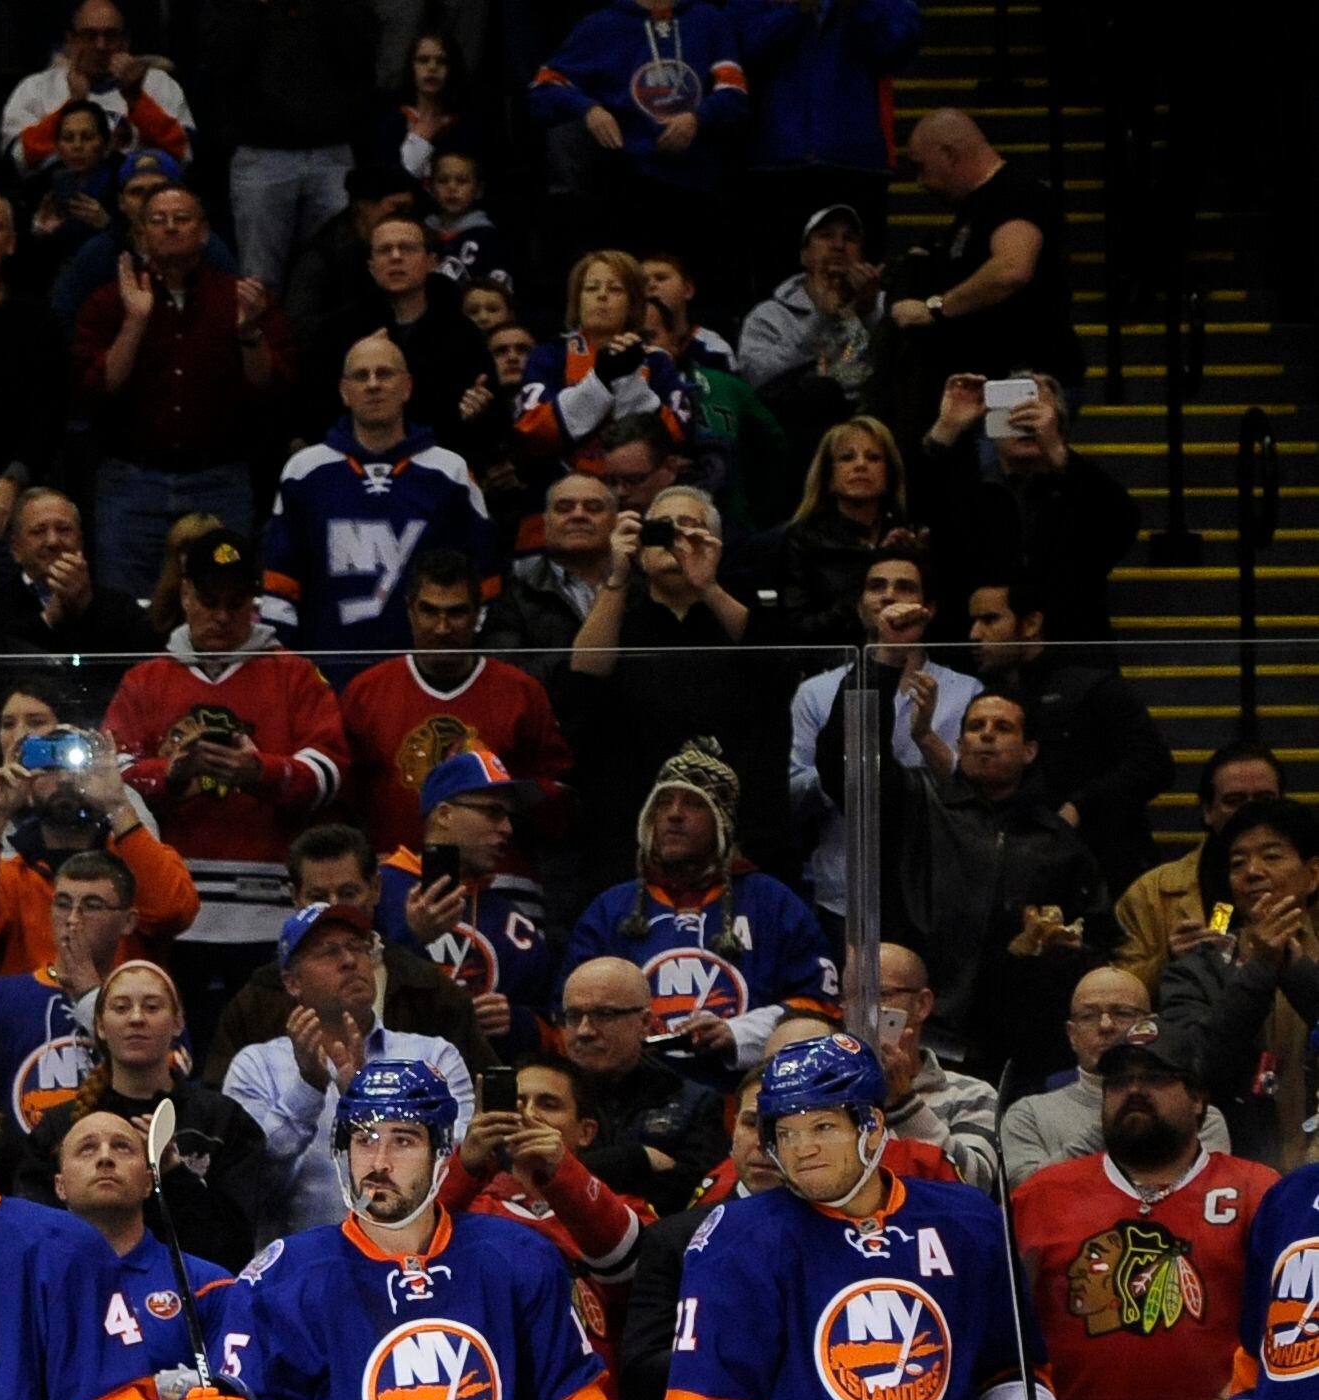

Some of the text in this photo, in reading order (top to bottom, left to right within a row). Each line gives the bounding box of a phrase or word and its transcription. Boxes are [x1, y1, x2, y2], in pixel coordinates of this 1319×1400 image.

[327, 518, 429, 626] NY
[505, 912, 535, 950] C
[659, 958, 721, 1009] NY
[1204, 1187, 1238, 1224] C
[918, 1227, 954, 1276] A
[104, 1292, 143, 1346] 4
[846, 1289, 923, 1342] NY
[392, 1331, 470, 1386] NY
